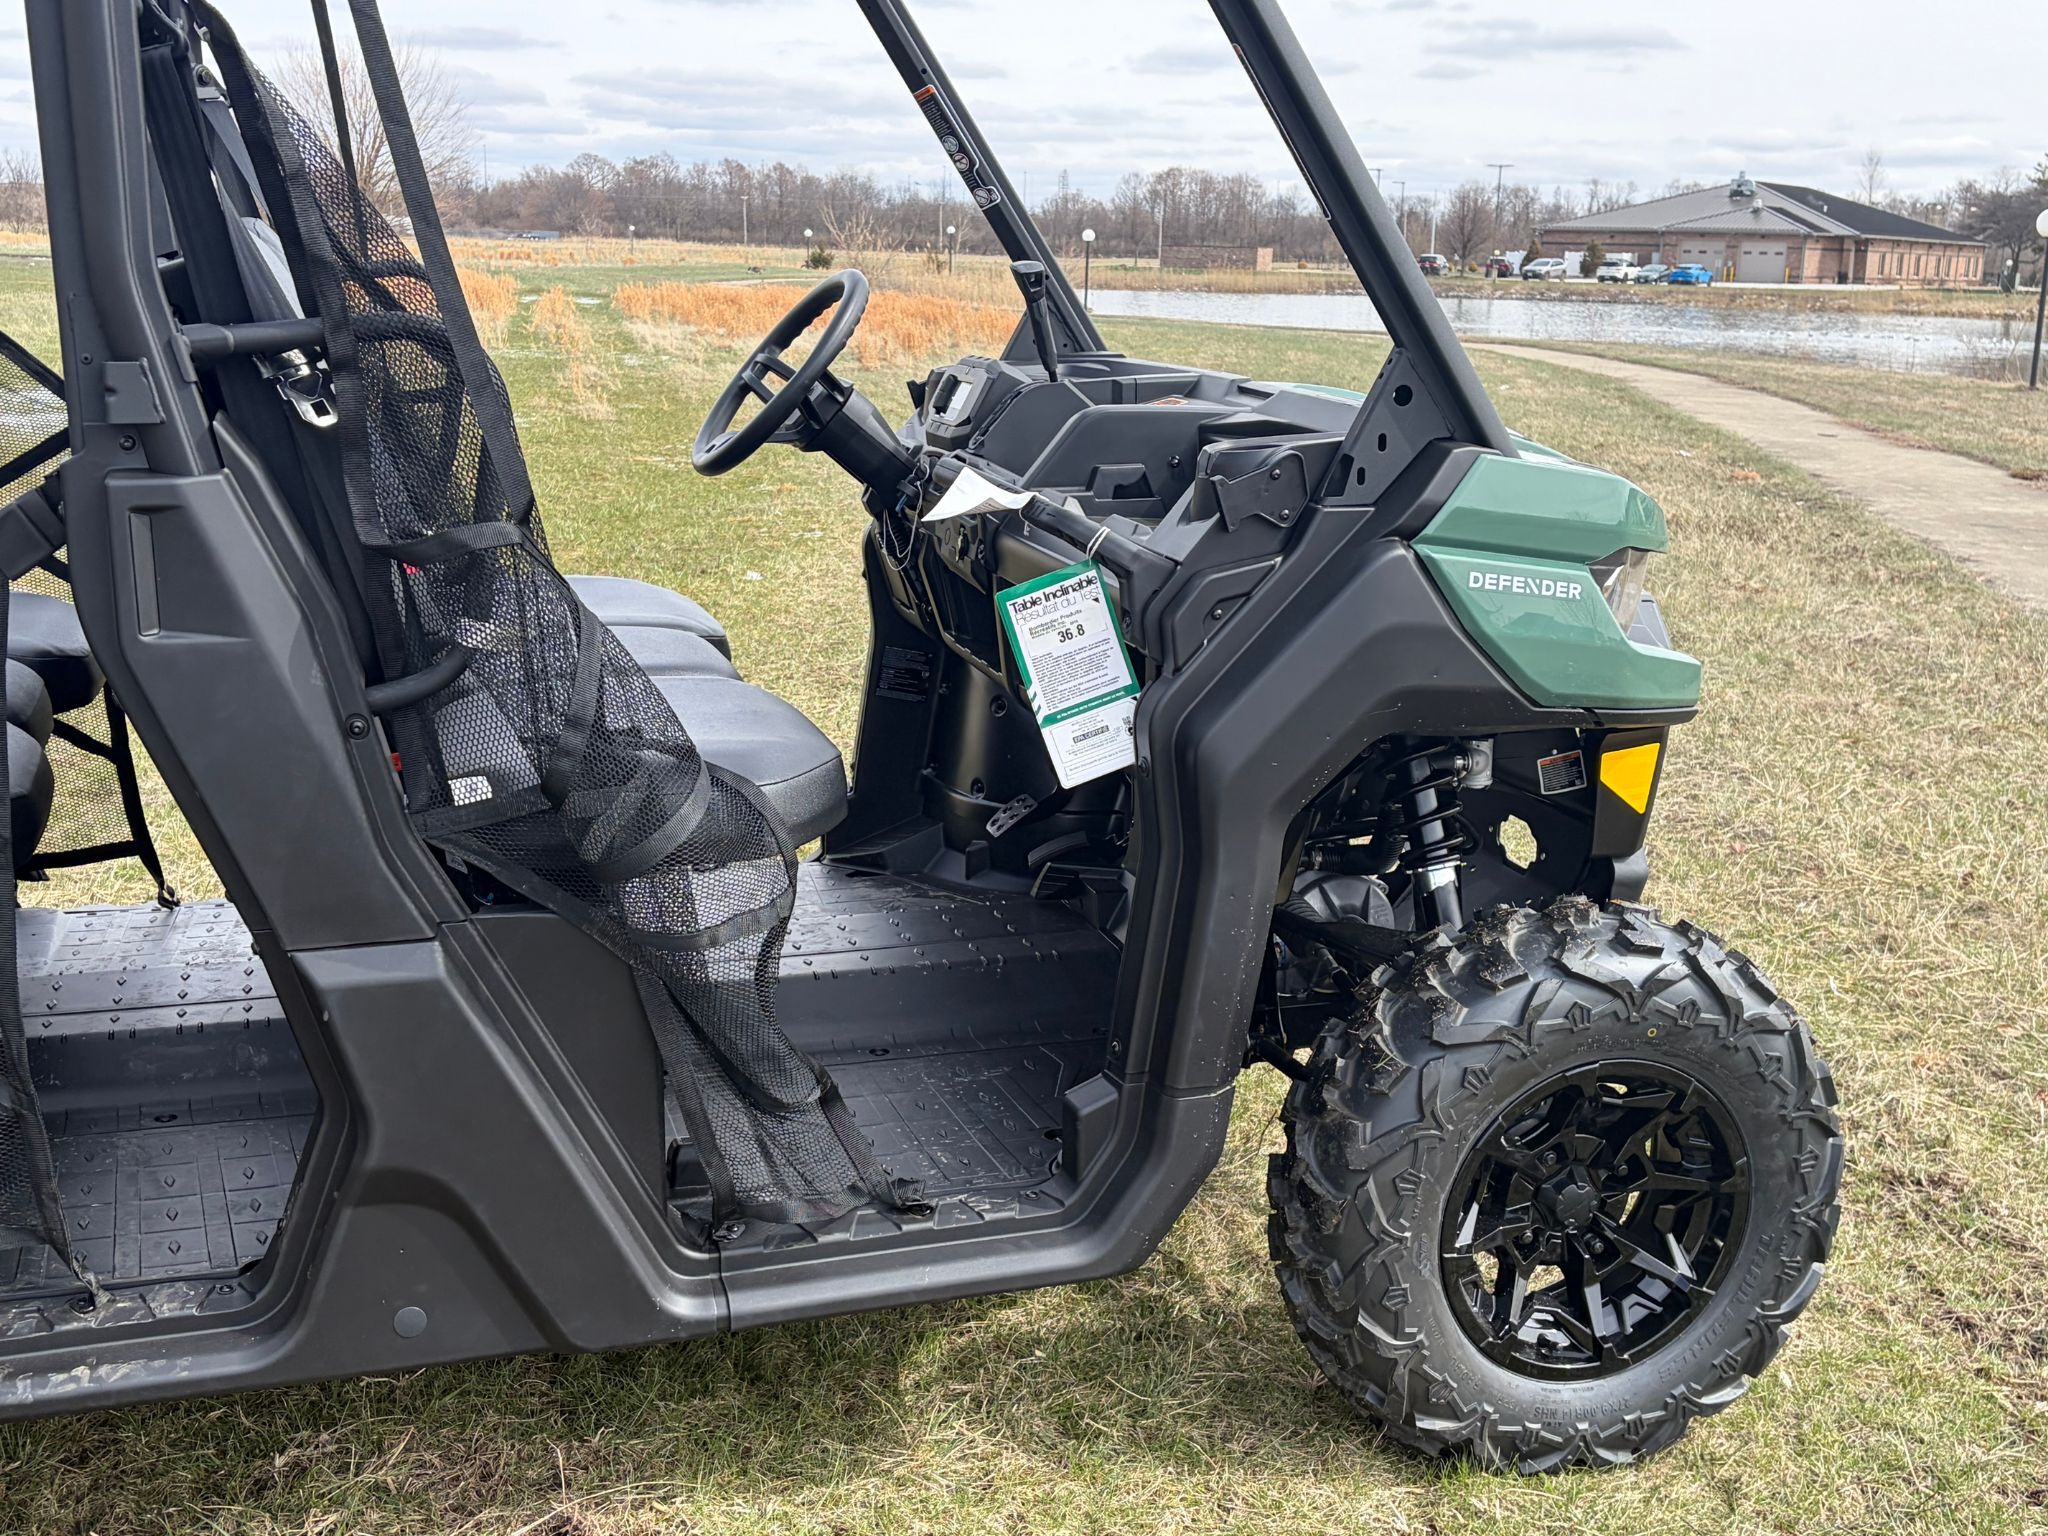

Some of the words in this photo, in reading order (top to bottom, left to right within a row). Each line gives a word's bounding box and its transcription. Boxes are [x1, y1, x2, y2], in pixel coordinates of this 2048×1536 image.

[1009, 597, 1042, 614] Table
[1043, 575, 1098, 603] Inclinable
[1061, 595, 1077, 609] du
[1080, 586, 1101, 601] Test
[1469, 571, 1582, 600] DEFENDER
[1057, 624, 1085, 643] 36.8
